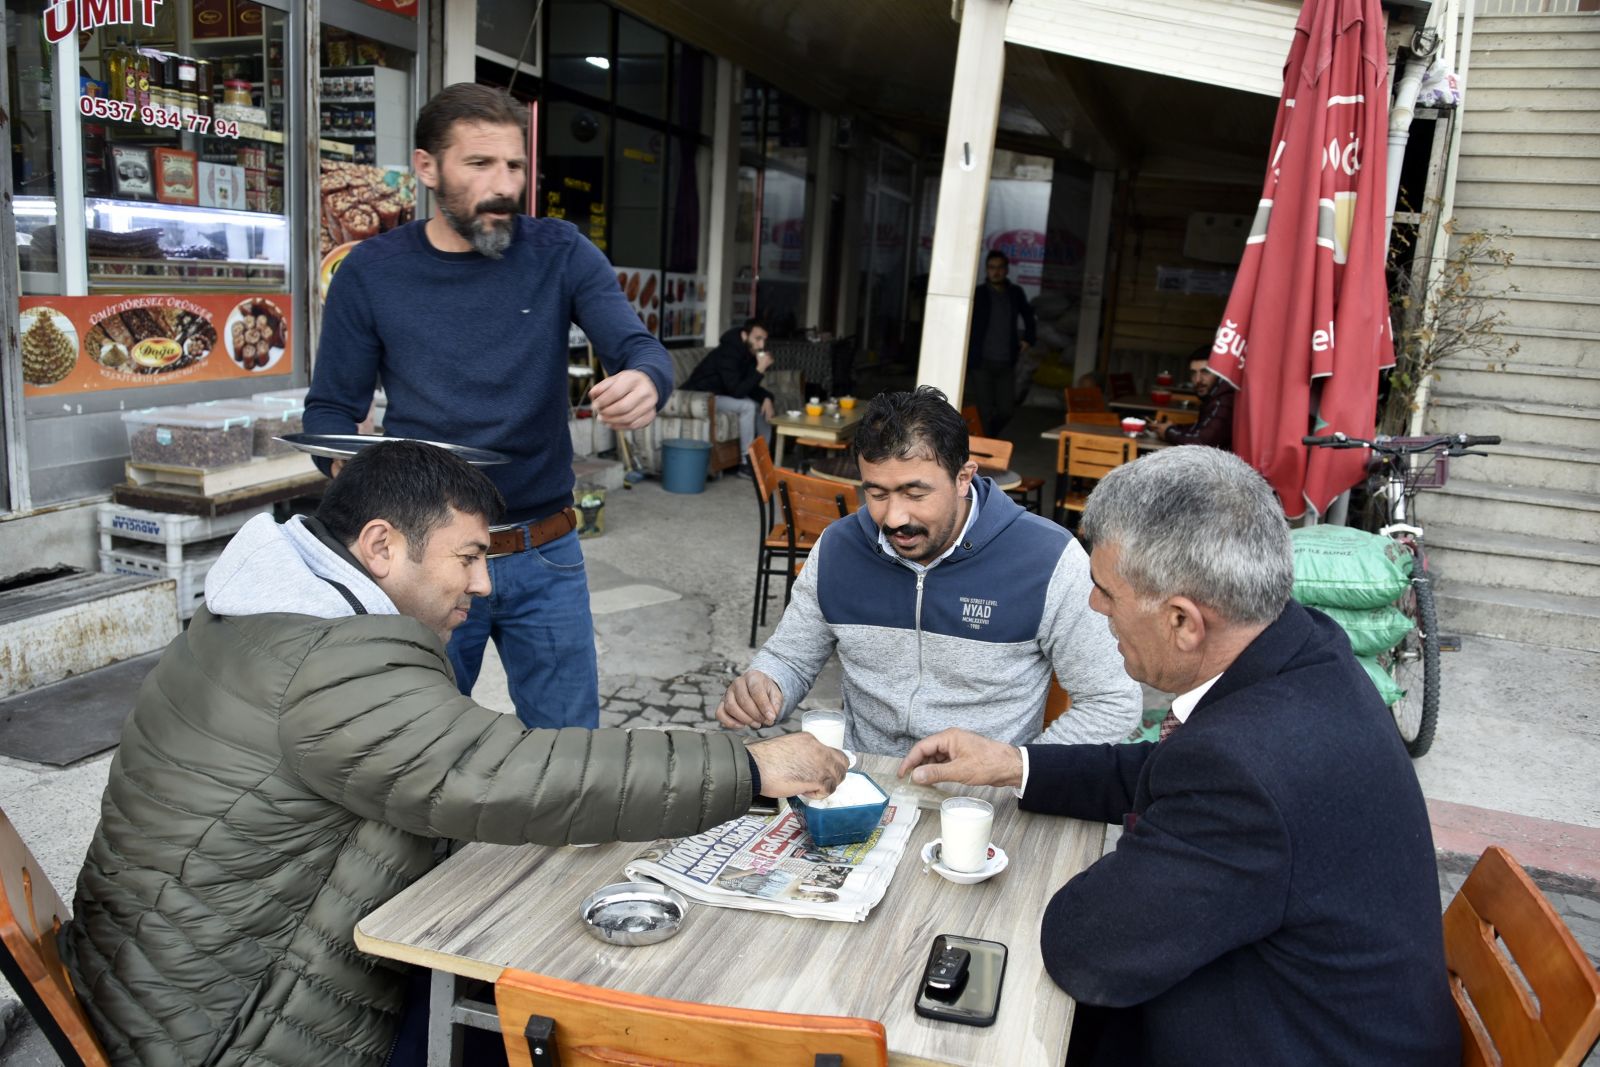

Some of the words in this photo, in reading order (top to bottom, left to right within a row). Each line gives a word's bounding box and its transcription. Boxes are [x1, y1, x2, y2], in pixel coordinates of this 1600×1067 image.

[80, 96, 135, 122] 0537
[142, 107, 181, 129] 934
[186, 114, 211, 135] 77
[215, 119, 240, 139] 94
[962, 603, 991, 619] NYAD
[686, 843, 736, 883] OLMAK
